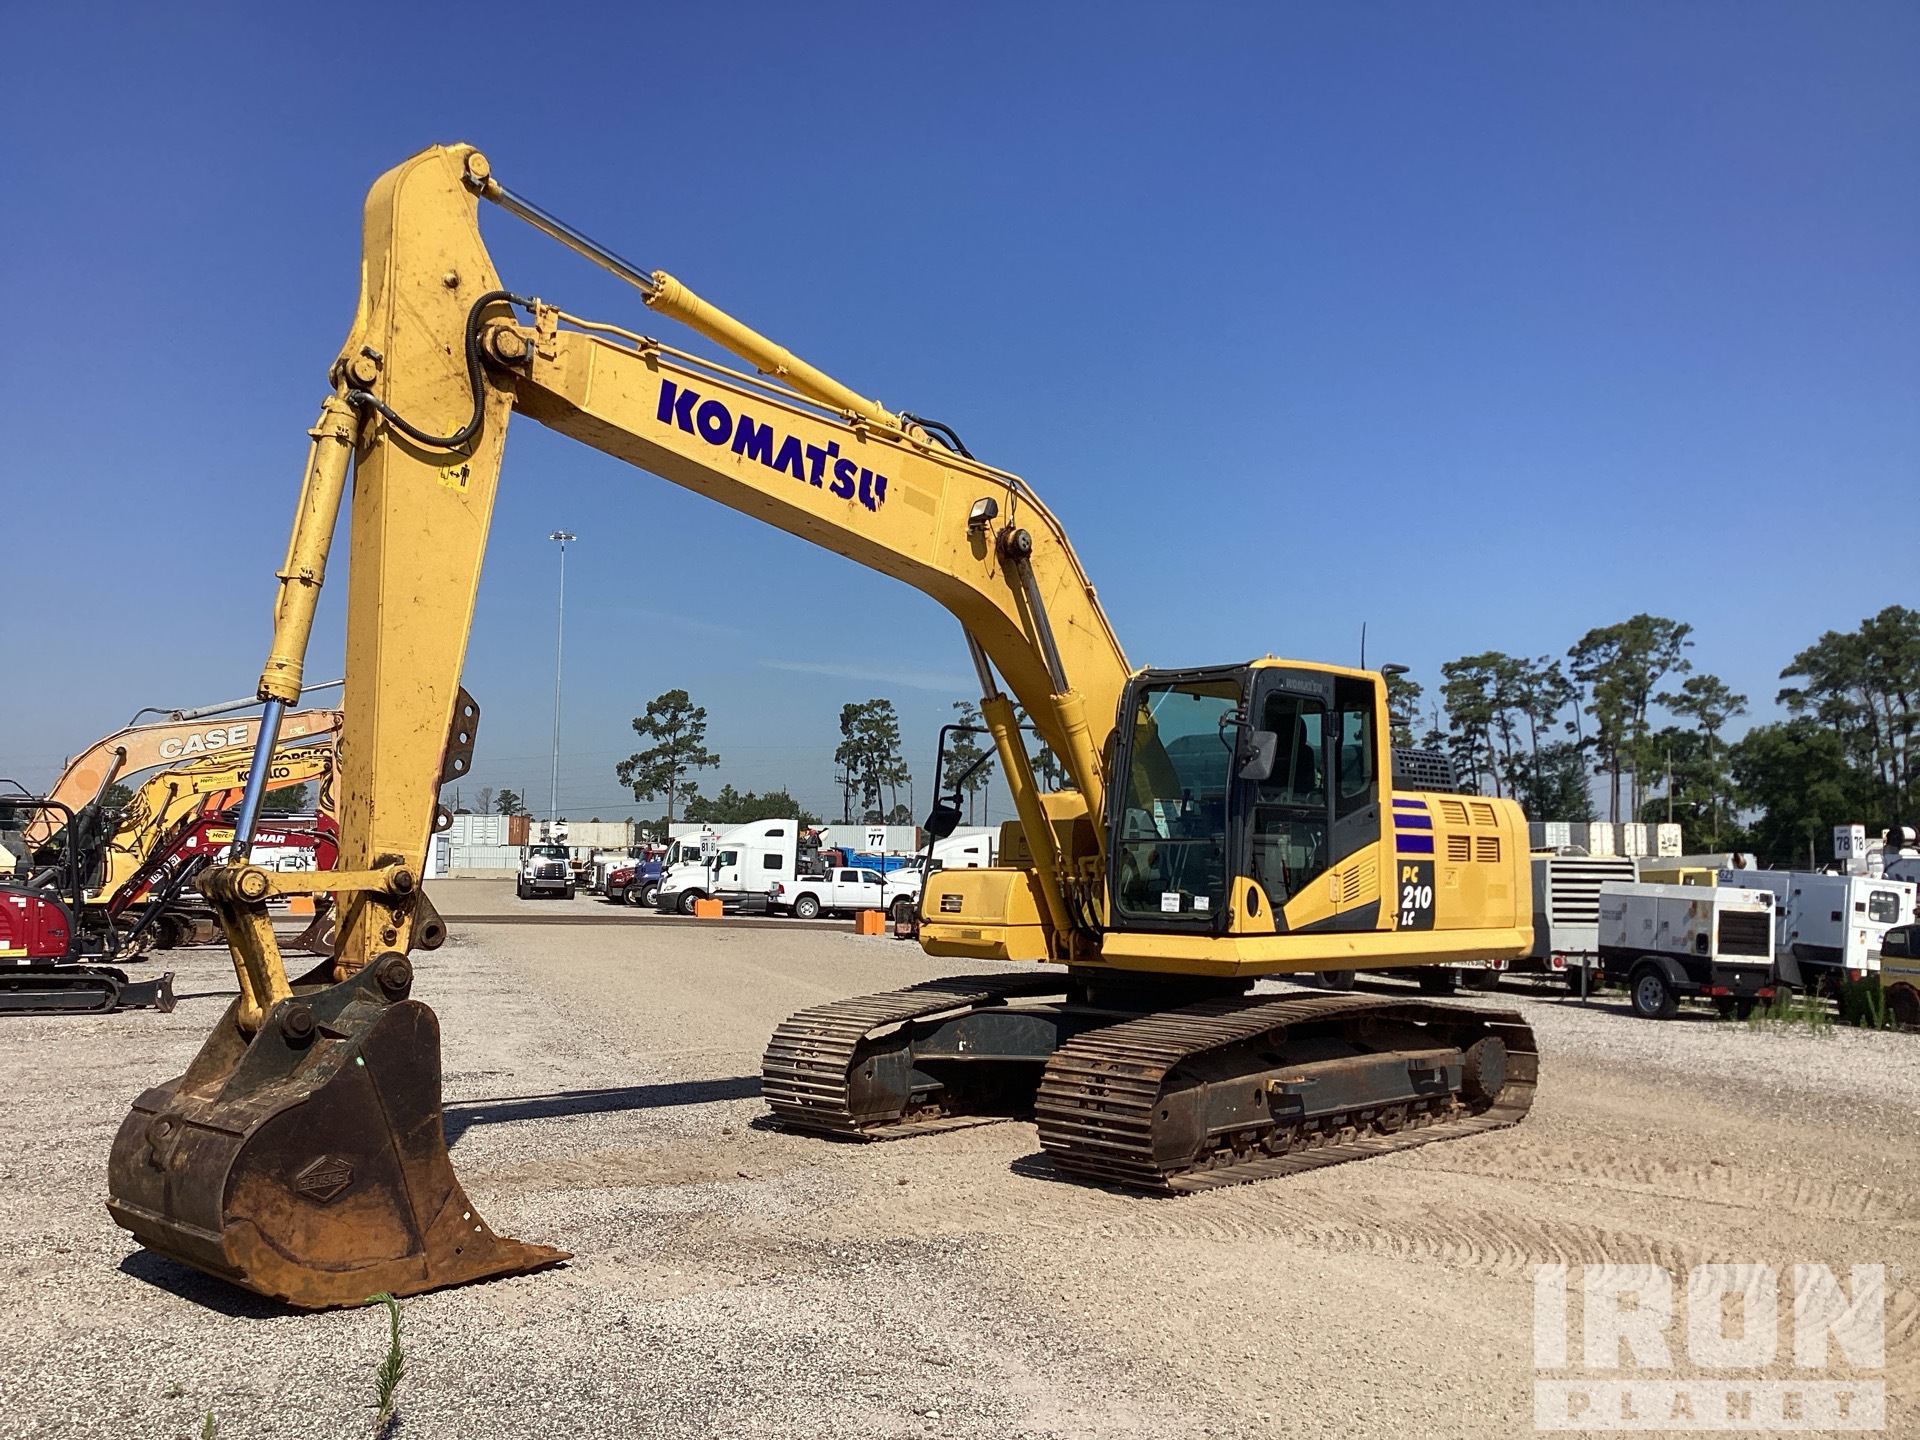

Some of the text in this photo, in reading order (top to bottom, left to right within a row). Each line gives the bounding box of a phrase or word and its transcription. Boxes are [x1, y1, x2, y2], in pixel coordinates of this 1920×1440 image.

[656, 378, 888, 512] KOMATSU
[159, 724, 249, 759] CASE
[254, 833, 286, 844] MAR
[868, 834, 884, 846] 77
[1836, 836, 1850, 850] 78
[1854, 836, 1864, 850] 78
[701, 842, 709, 852] 81
[1402, 866, 1419, 883] PC
[1401, 885, 1432, 909] 210
[1401, 911, 1415, 925] LC
